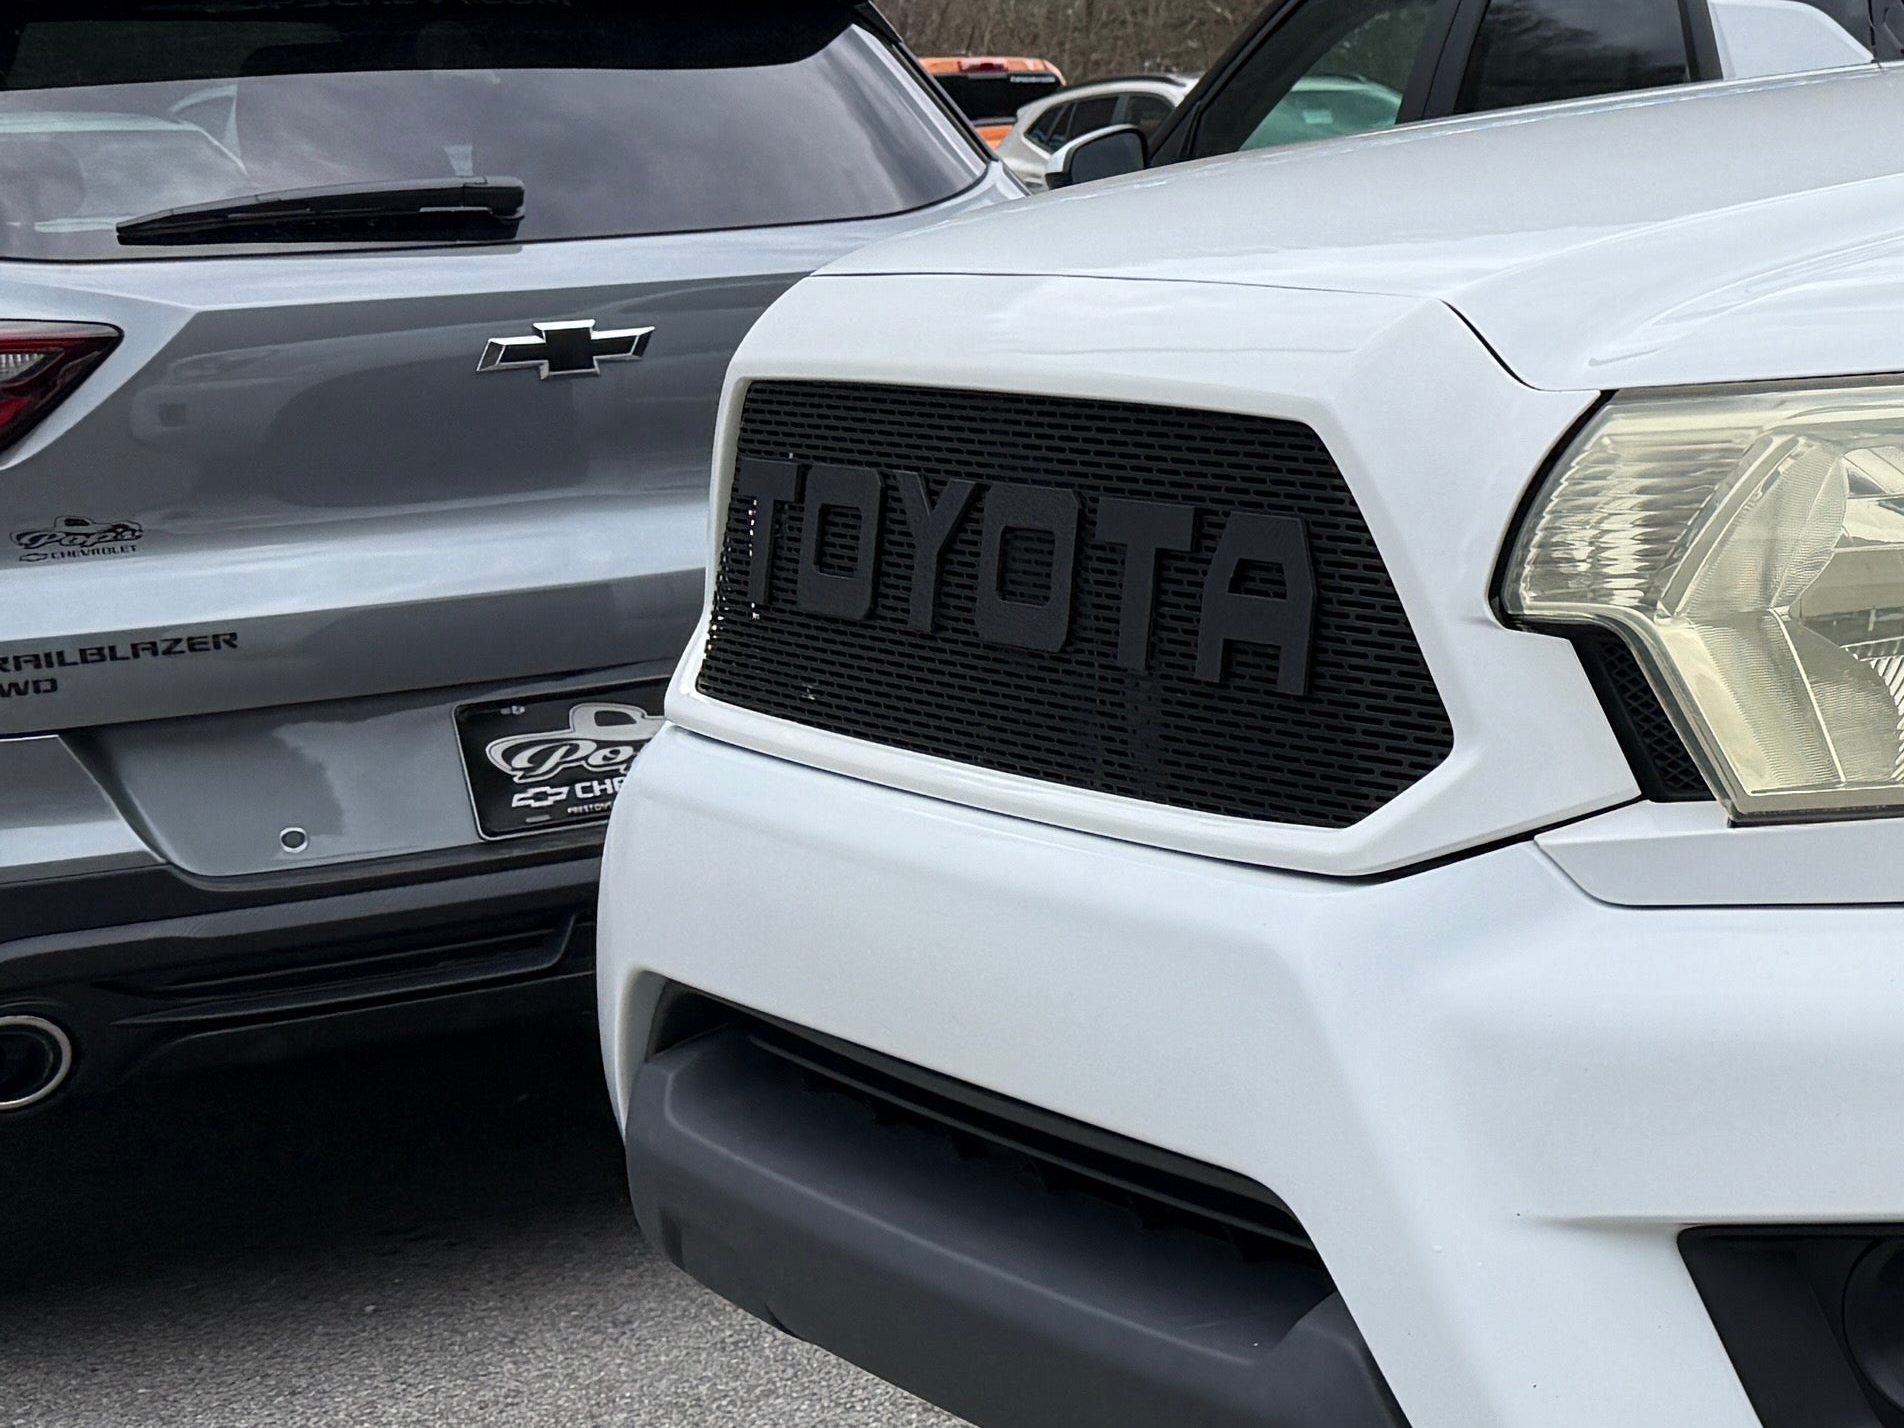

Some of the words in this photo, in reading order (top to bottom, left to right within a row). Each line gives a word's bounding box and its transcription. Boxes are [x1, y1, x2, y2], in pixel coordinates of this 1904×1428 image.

[51, 544, 137, 560] CHEVROLET
[736, 455, 1318, 697] TOYOTA
[510, 738, 641, 775] Po
